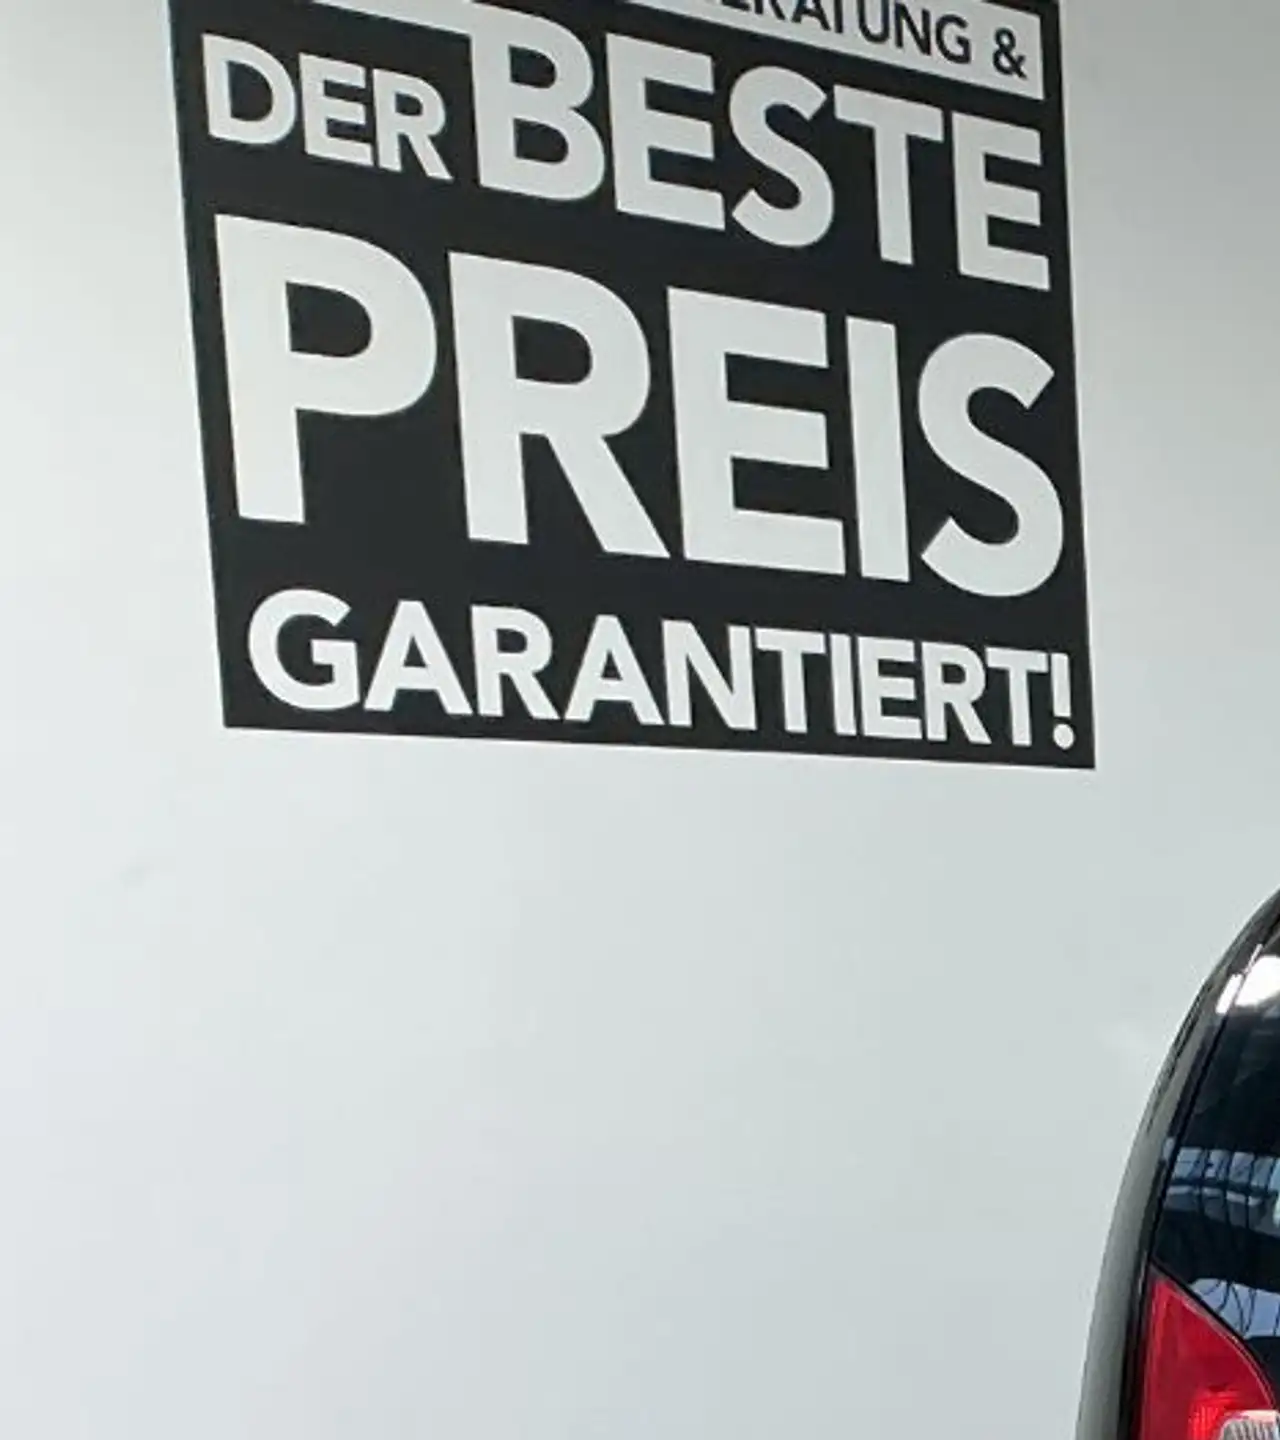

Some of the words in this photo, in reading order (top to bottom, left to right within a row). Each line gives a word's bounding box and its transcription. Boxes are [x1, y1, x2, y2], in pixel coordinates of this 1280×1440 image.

[202, 33, 453, 181] DER
[464, 0, 1051, 292] BESTE
[992, 27, 1028, 80] &
[214, 213, 1065, 598] PREIS
[247, 587, 1076, 751] GARANTIERT!
